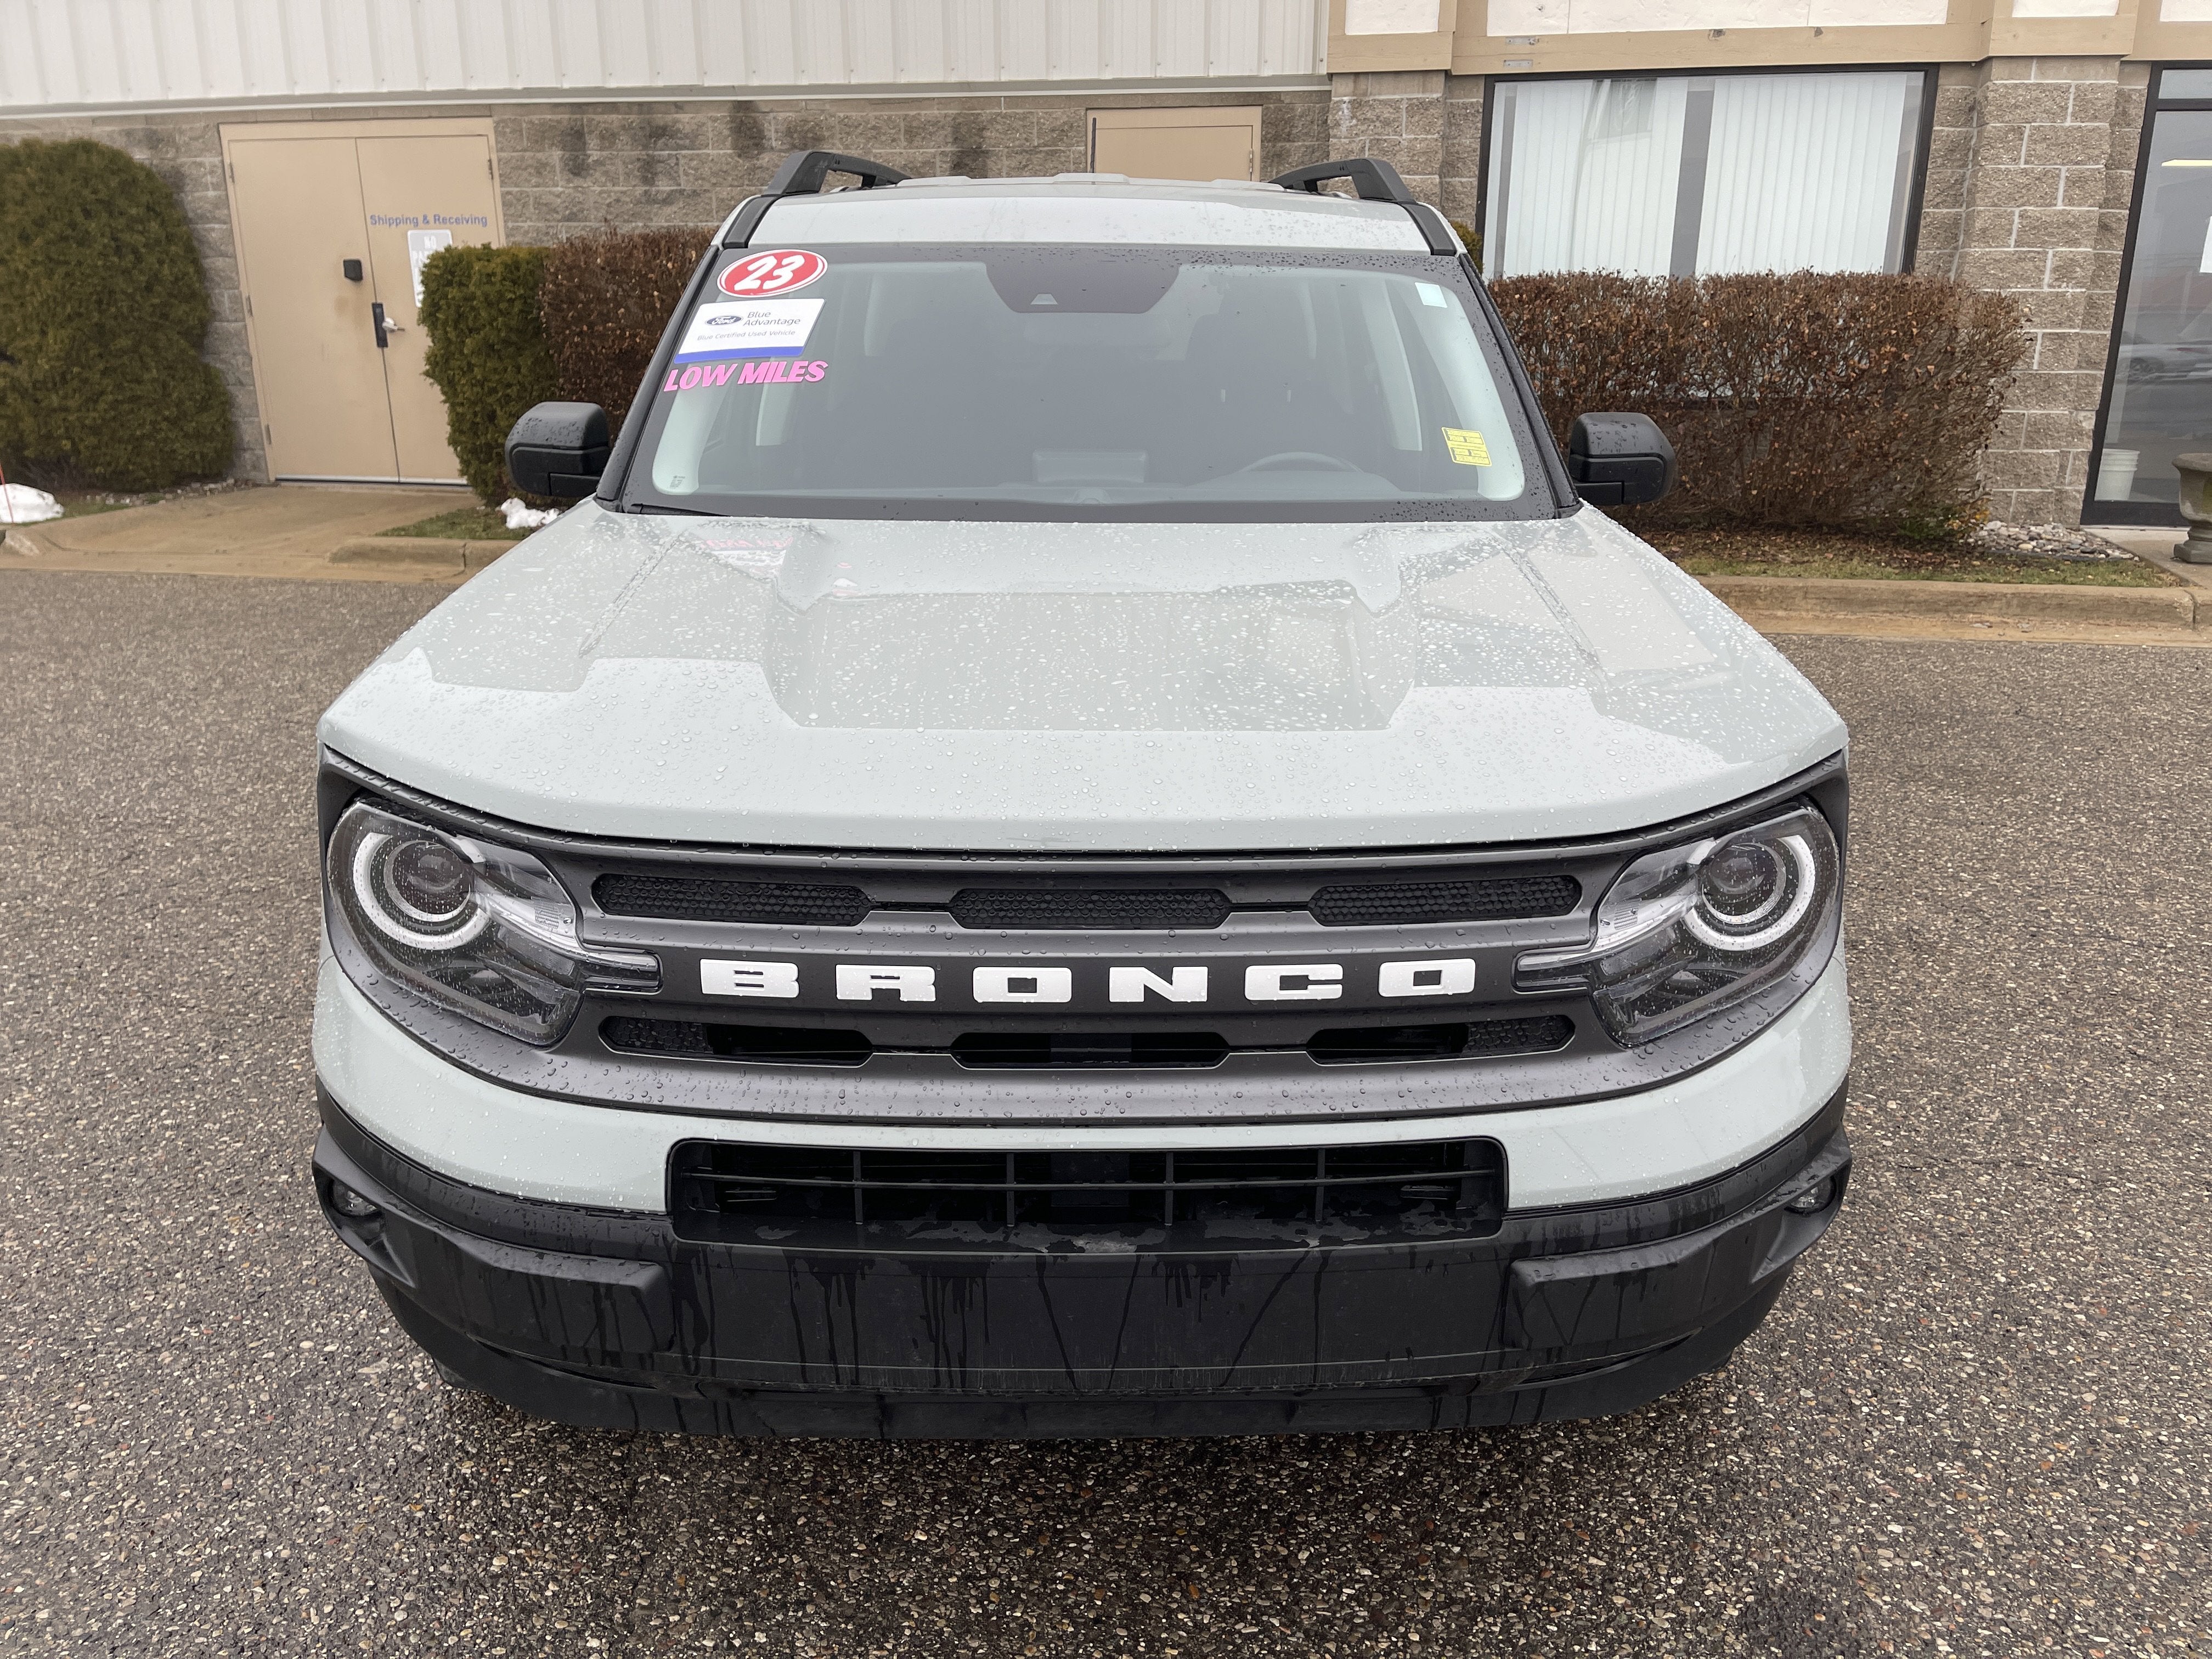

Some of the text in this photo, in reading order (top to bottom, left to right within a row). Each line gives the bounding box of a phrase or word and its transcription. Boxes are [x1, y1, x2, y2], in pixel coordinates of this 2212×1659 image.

[370, 214, 488, 228] Shipping & Receiving
[424, 235, 437, 249] NO
[733, 255, 805, 291] 23
[743, 318, 801, 326] Advantage
[663, 360, 828, 392] LOW MILES
[700, 958, 1476, 1003] BRONCO
